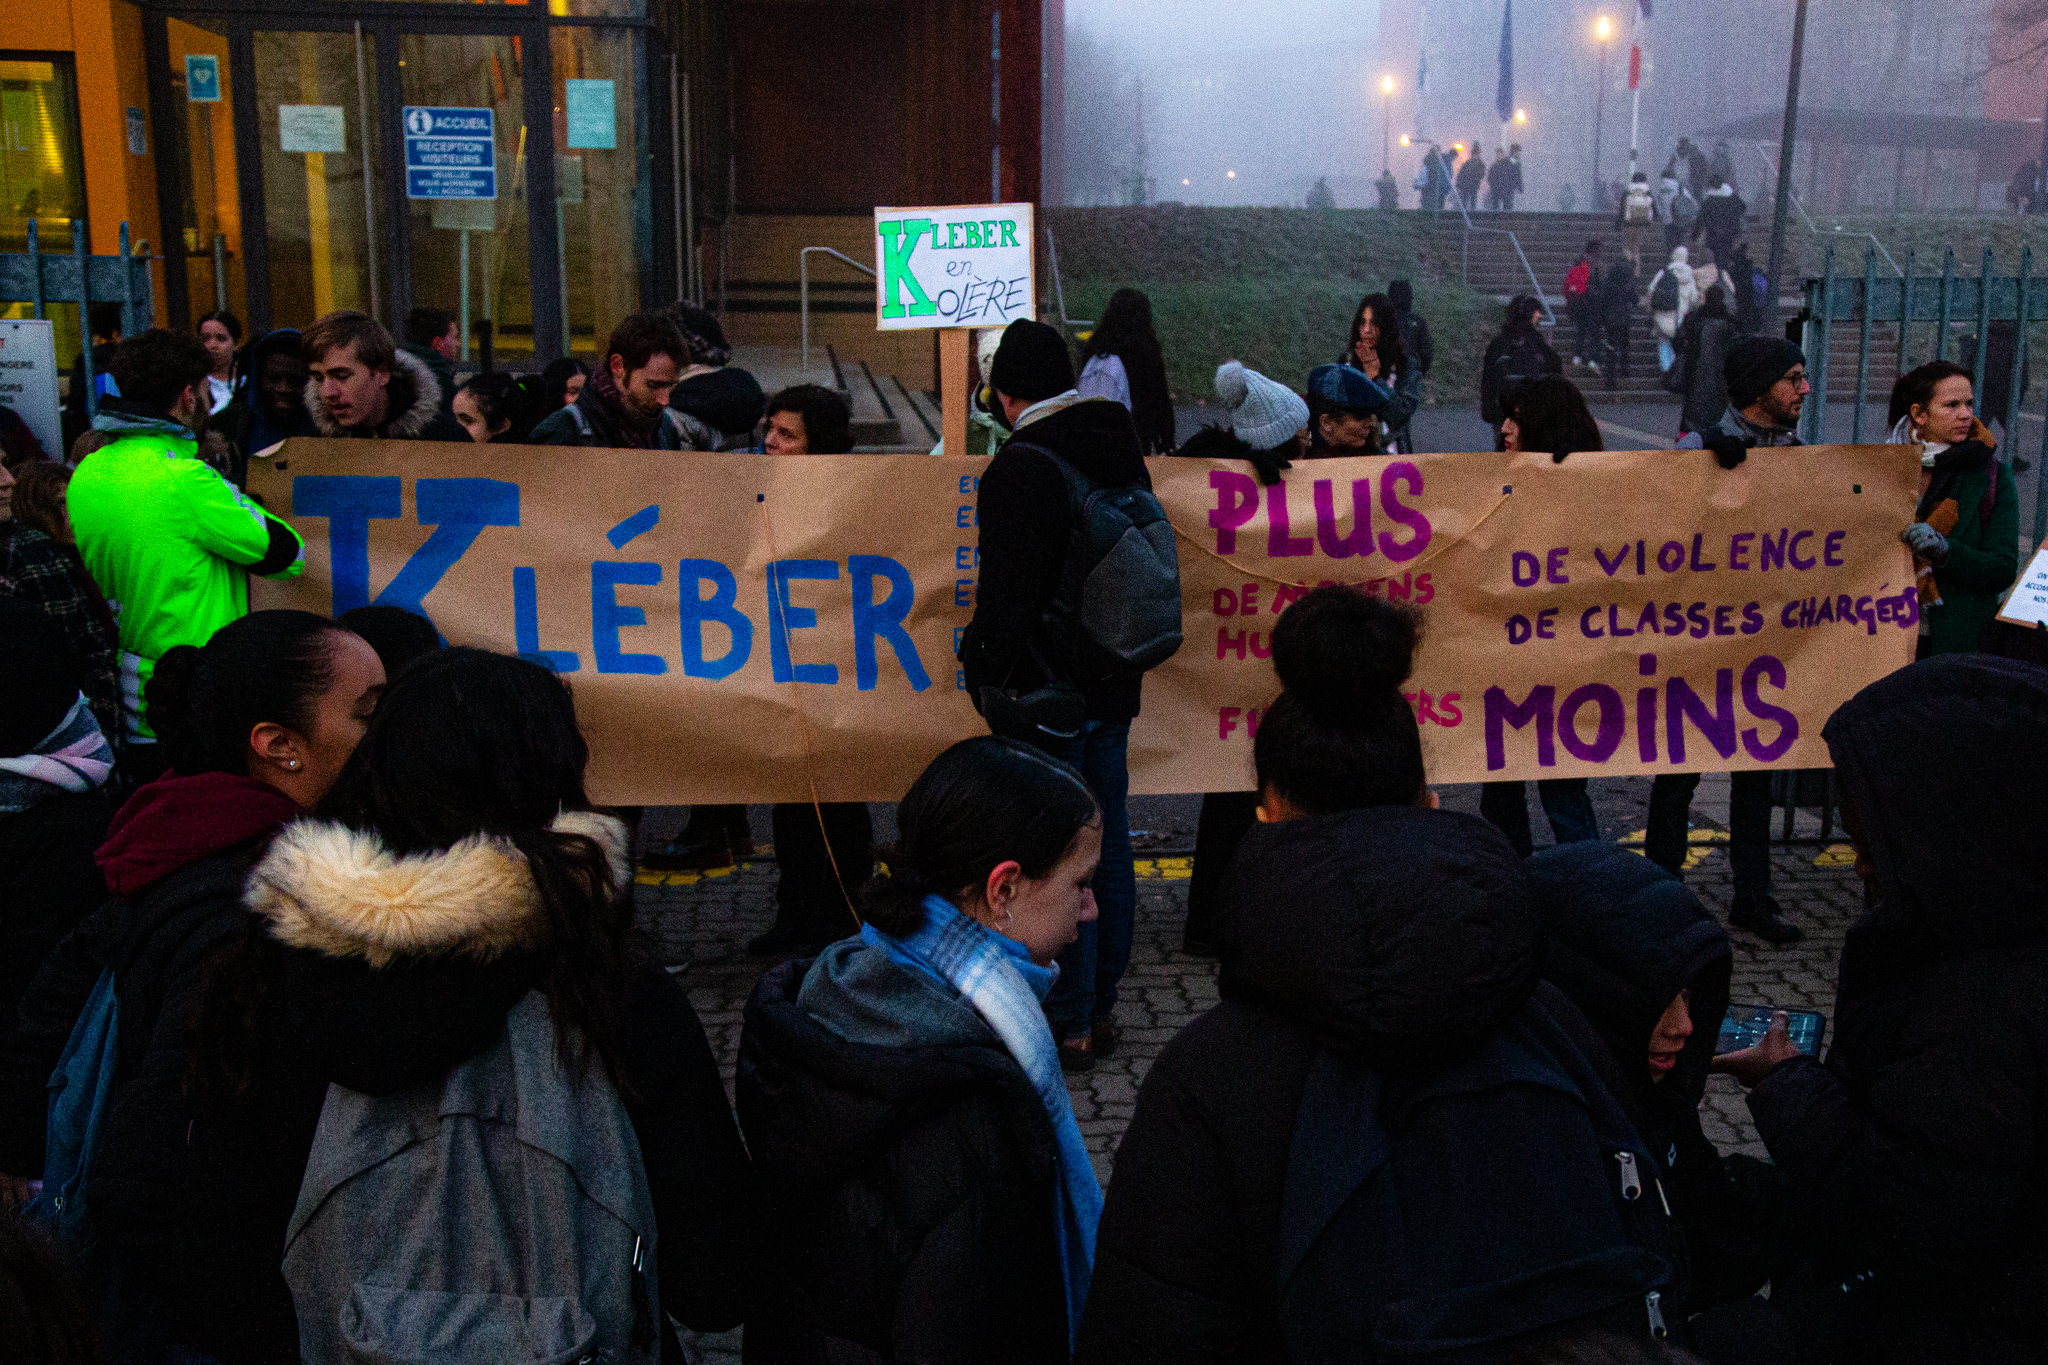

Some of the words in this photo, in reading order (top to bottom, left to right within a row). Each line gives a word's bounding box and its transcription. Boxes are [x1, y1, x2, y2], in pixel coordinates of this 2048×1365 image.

[434, 116, 490, 130] ACCUEIL
[1207, 461, 1433, 563] PLUS
[292, 475, 932, 693] KLÉBER
[1510, 546, 1570, 588] DE
[1594, 527, 1847, 577] VIOLENCE
[1212, 582, 1260, 617] DE
[1504, 607, 1560, 645] DE
[1579, 600, 1765, 639] CLASSES
